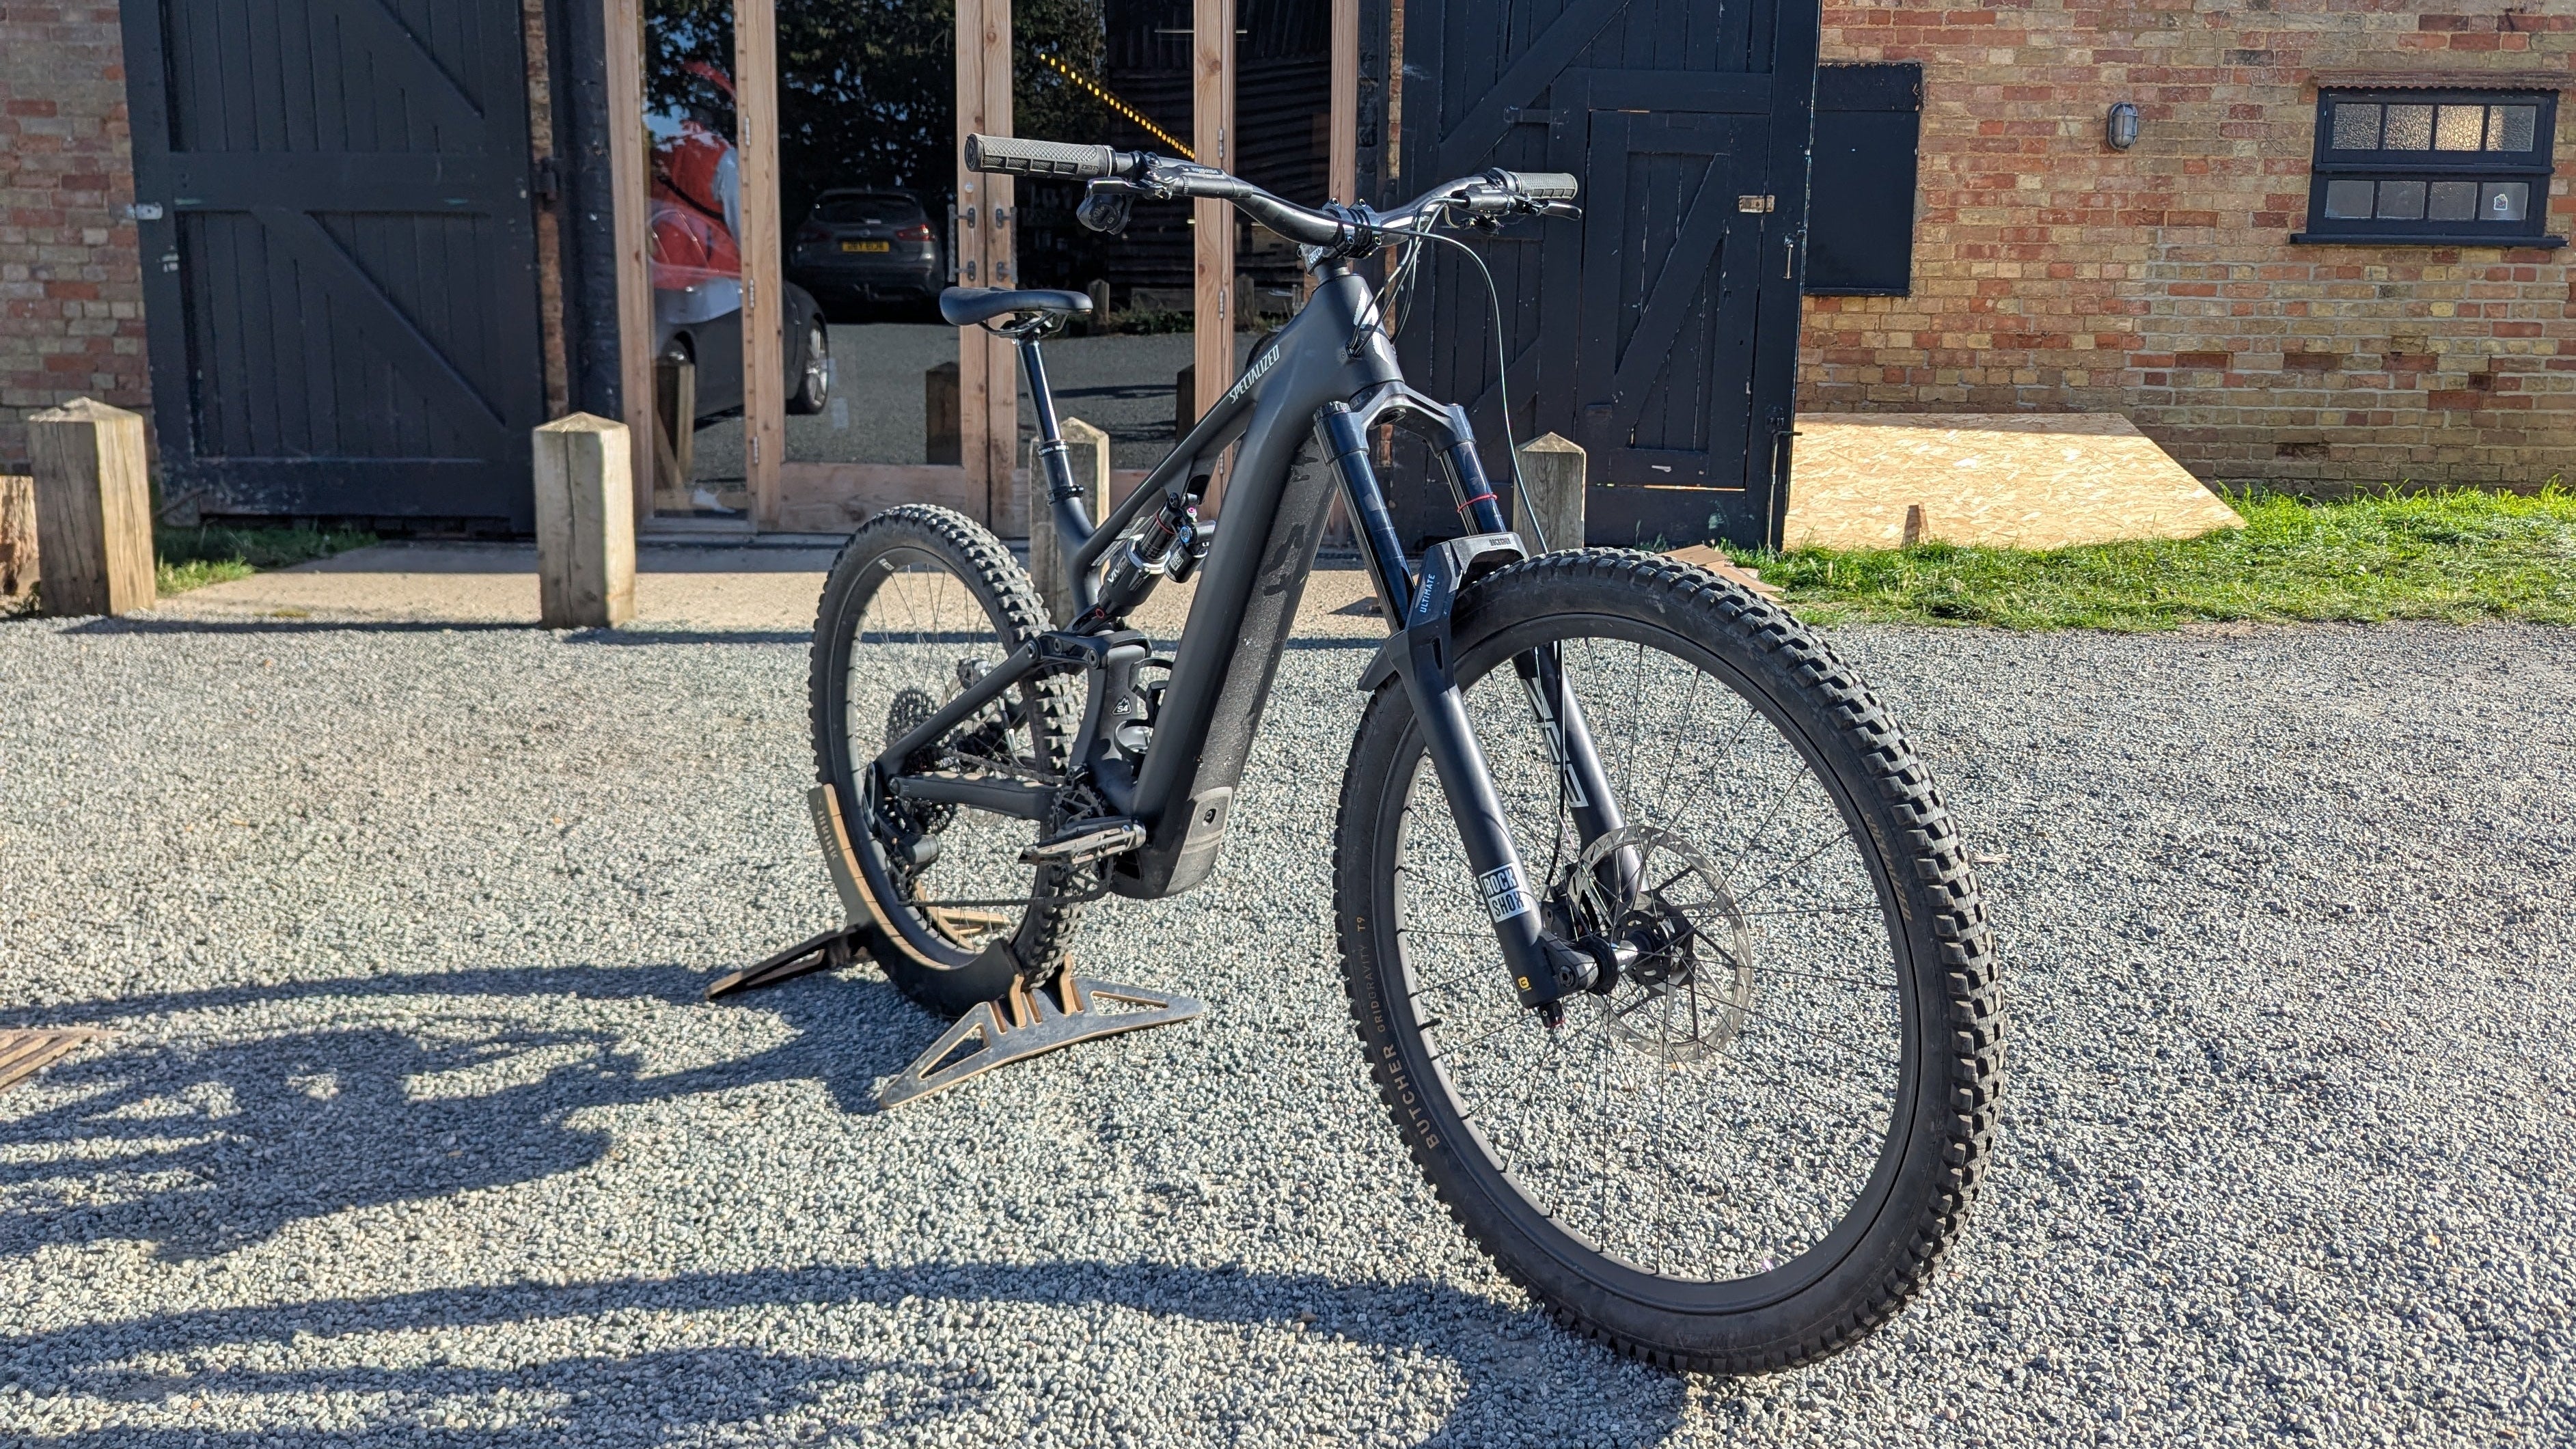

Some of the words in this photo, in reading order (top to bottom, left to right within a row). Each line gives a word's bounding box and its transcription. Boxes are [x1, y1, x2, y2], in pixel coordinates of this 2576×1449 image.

[1229, 344, 1280, 404] SPECIALIZED
[1420, 574, 1435, 613] ULTIMATE
[1483, 868, 1516, 896] ROCK
[1492, 891, 1524, 917] SHOX
[1356, 917, 1366, 932] T9
[1383, 1044, 1440, 1149] BUTCHER
